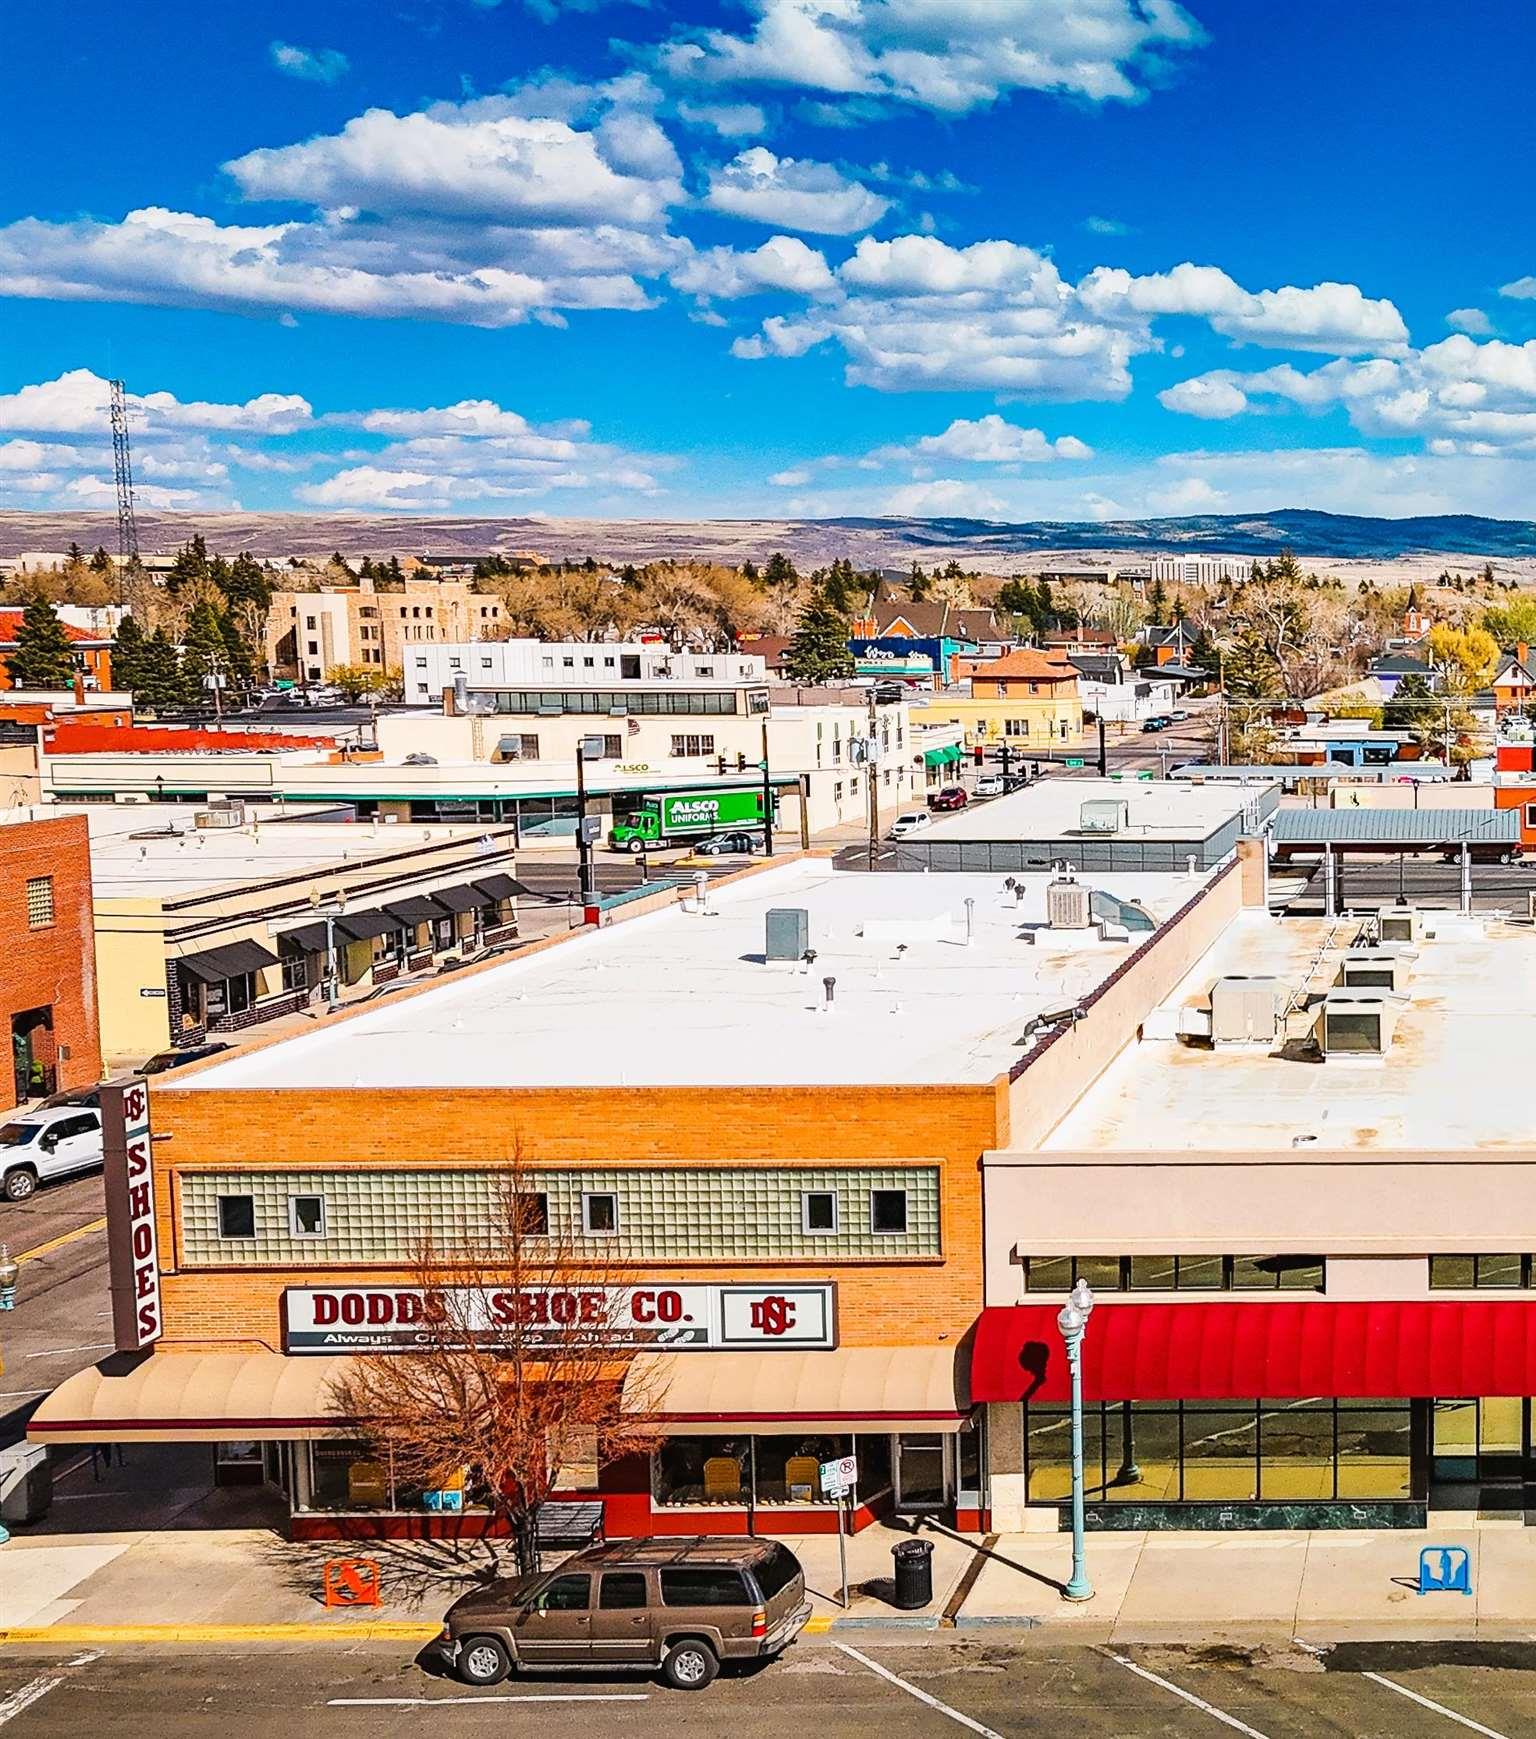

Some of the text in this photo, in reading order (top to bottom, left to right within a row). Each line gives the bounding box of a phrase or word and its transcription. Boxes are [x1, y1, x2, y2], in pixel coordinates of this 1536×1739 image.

[669, 800, 719, 814] ALSCO
[127, 1141, 158, 1340] SHOES
[313, 1290, 694, 1326] DODDS SHOE CO.
[323, 1333, 393, 1345] Always
